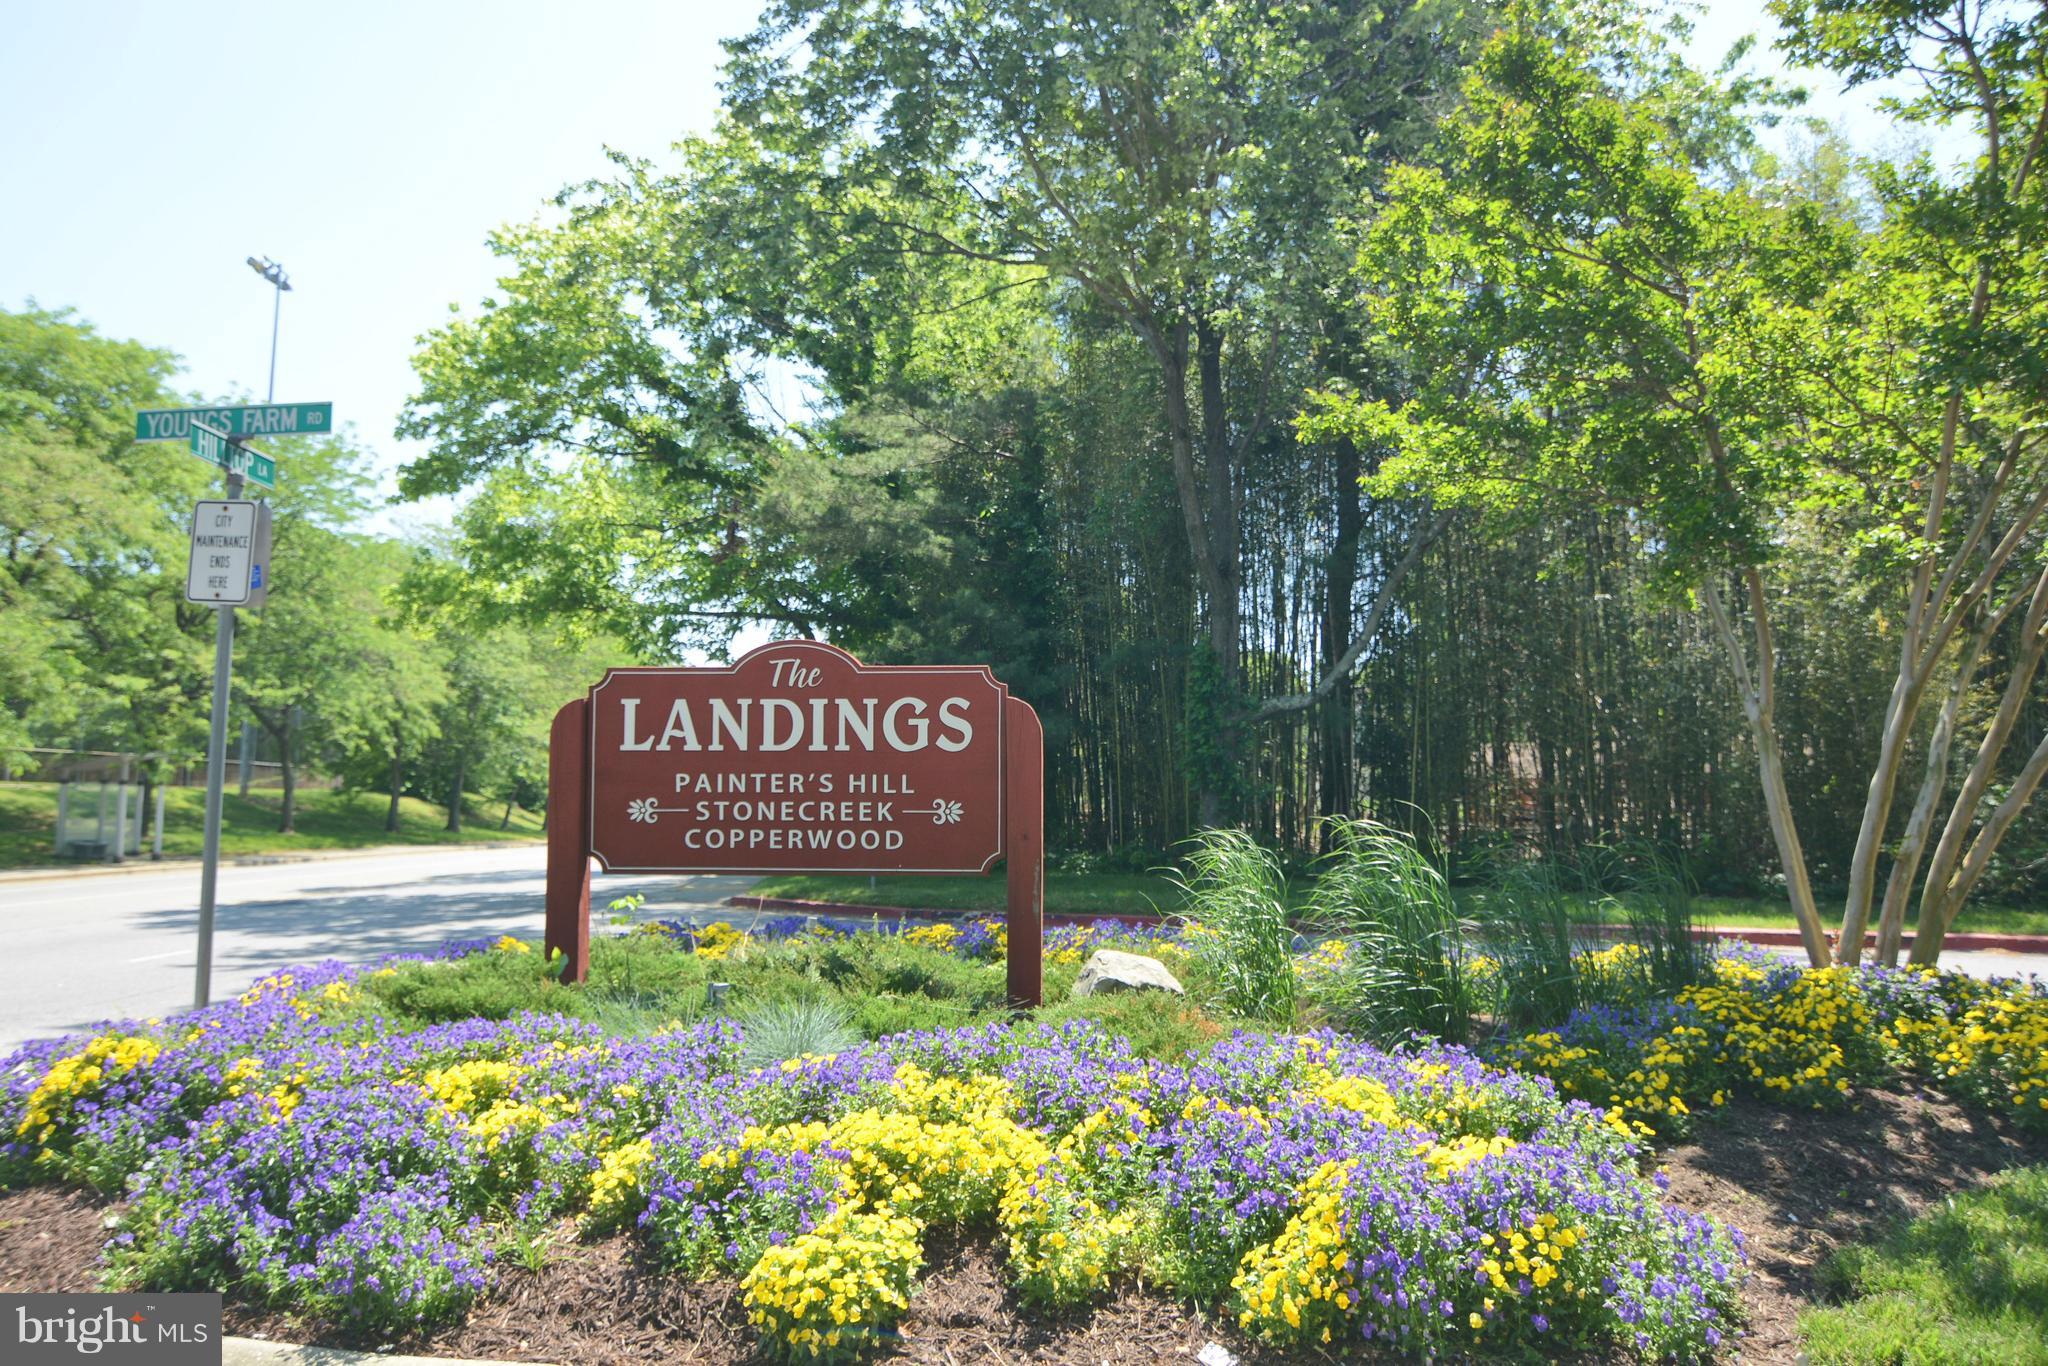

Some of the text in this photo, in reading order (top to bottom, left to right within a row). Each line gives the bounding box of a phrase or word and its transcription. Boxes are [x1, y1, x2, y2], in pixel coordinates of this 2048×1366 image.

[243, 407, 298, 433] FARM
[307, 411, 323, 425] RD
[215, 515, 233, 528] CITY
[196, 535, 248, 548] MAINTENANCE
[209, 555, 231, 568] ENDS
[208, 576, 228, 588] HERE
[768, 658, 823, 688] The
[619, 697, 974, 753] LANDINGS
[675, 773, 915, 794] PAINTER'S HILL
[696, 801, 894, 822] STONECREEK
[684, 829, 904, 850] COPPERWOOD
